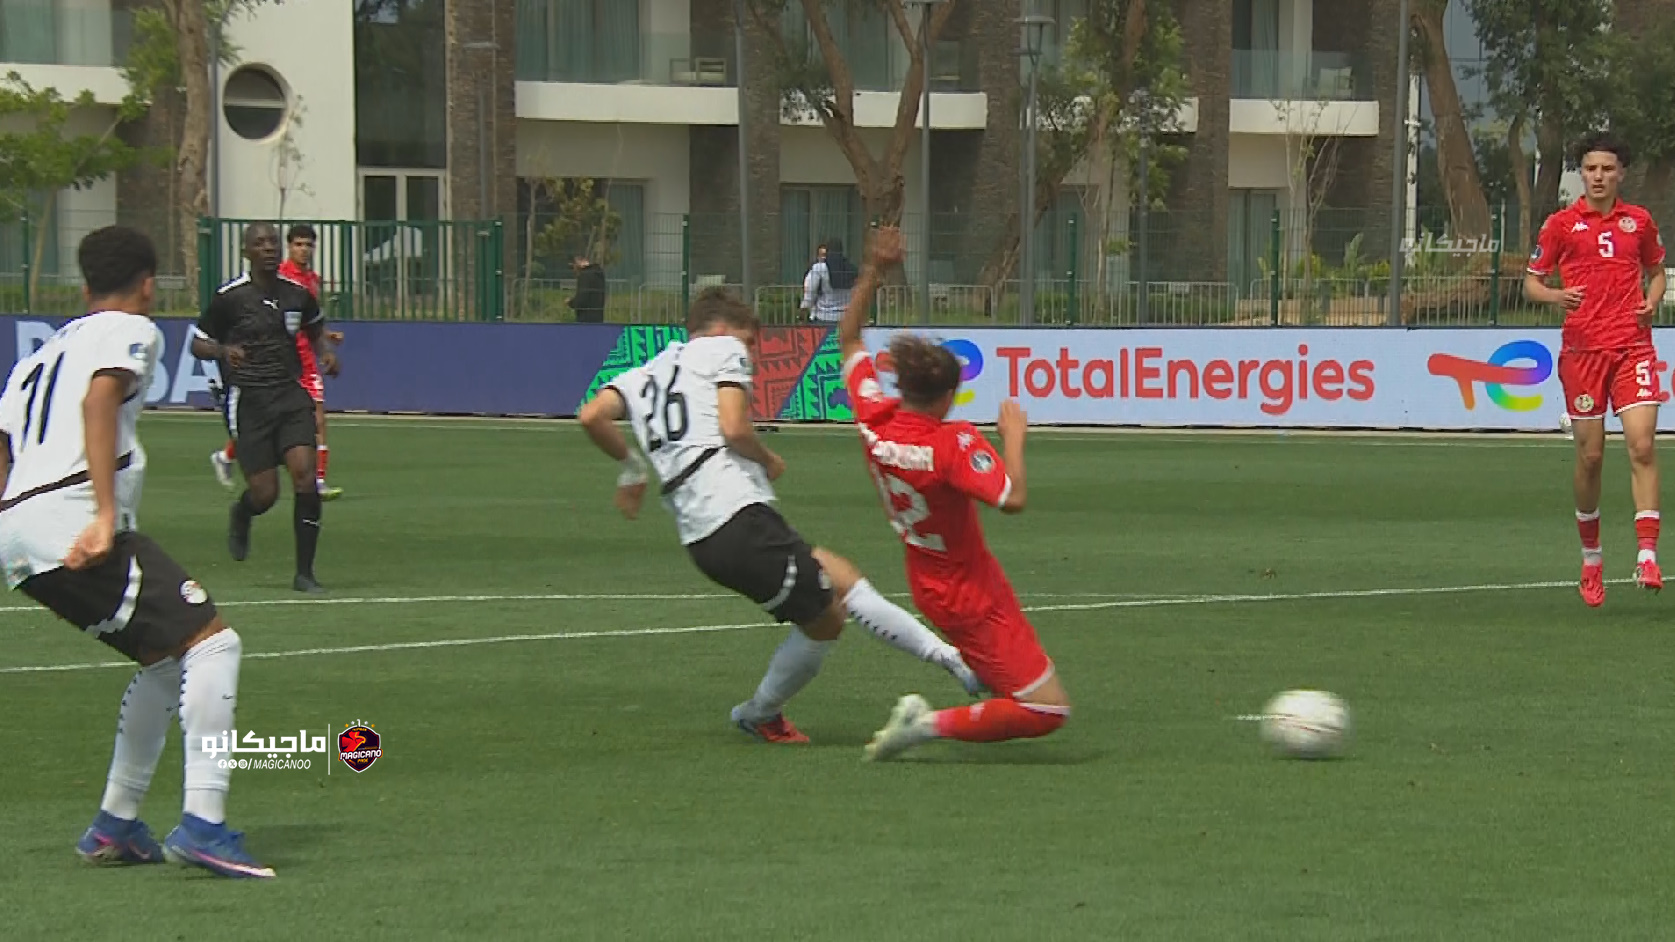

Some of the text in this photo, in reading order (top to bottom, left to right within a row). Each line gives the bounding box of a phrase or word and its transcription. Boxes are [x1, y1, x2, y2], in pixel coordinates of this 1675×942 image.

[1598, 231, 1614, 257] 5
[20, 350, 66, 449] 11
[640, 365, 689, 453] 26
[996, 343, 1376, 415] TotalEnergies
[1636, 360, 1650, 386] 5
